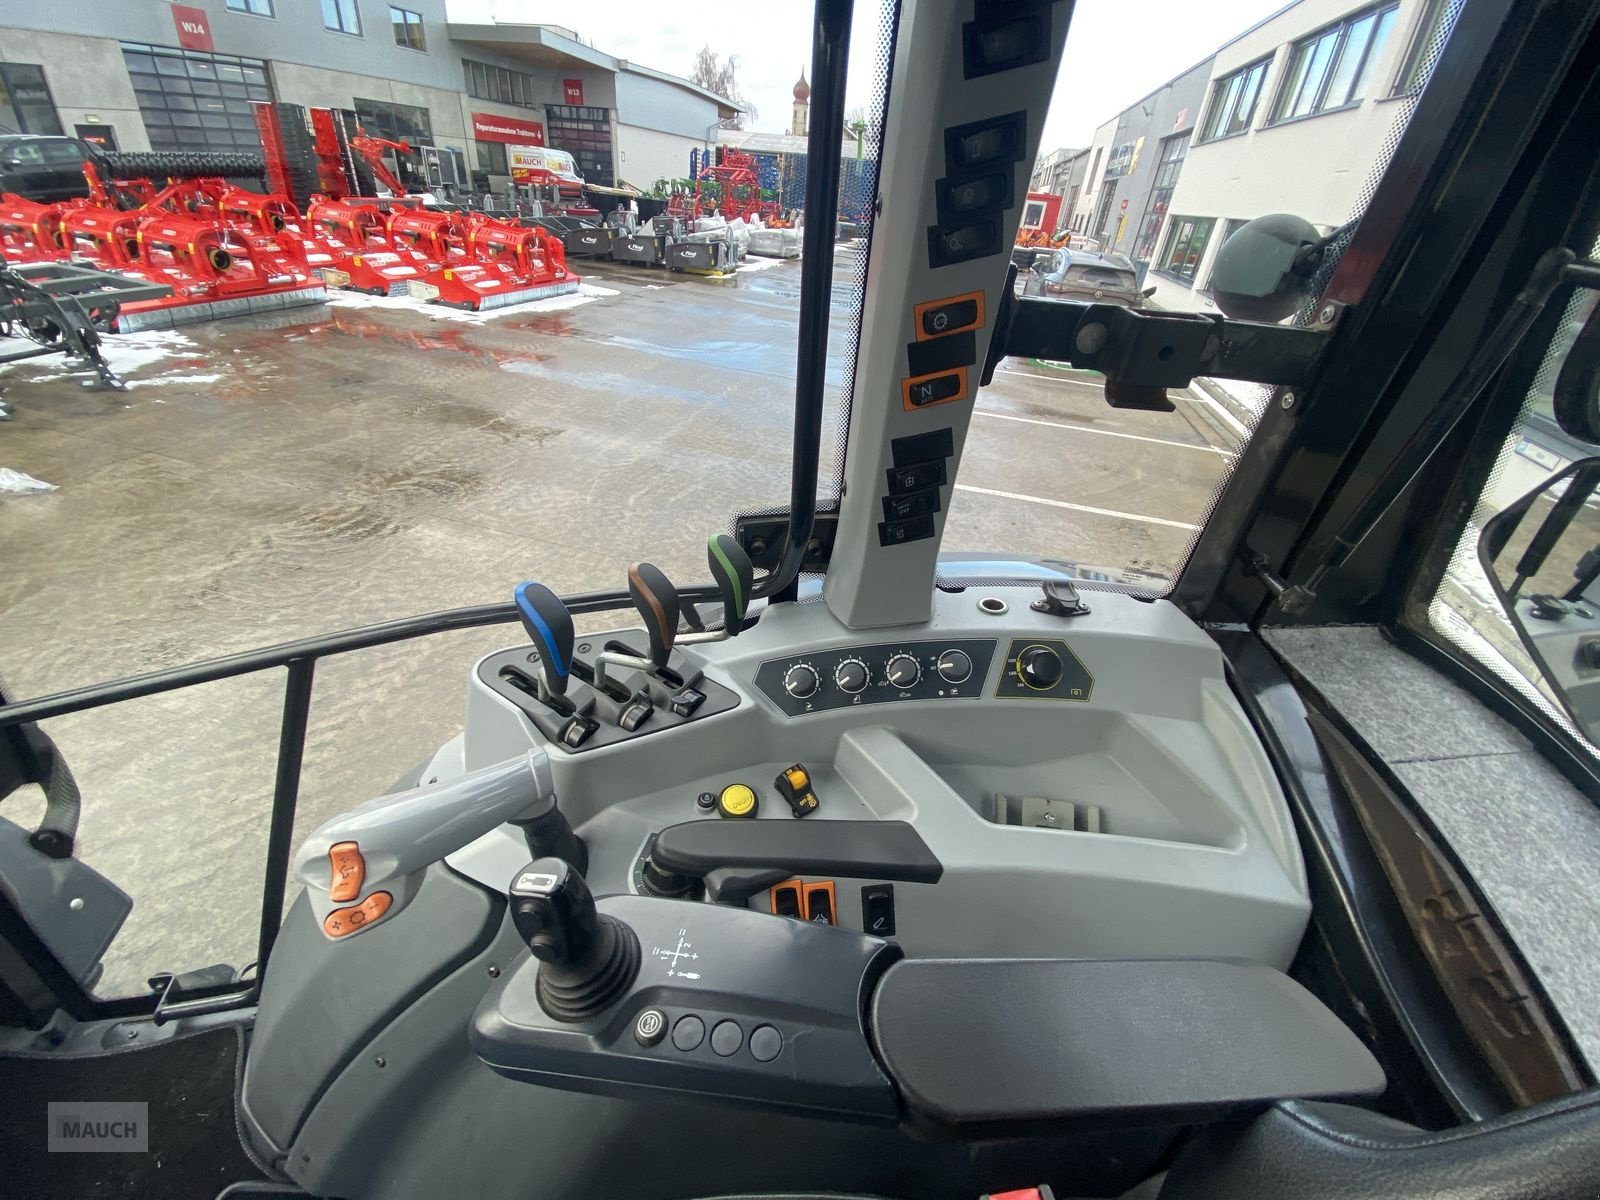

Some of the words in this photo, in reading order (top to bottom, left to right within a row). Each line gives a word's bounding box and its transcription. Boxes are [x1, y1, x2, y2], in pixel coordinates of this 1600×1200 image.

[181, 21, 205, 35] W14
[567, 88, 580, 96] W13
[515, 156, 542, 166] MAUCH
[921, 384, 932, 398] N
